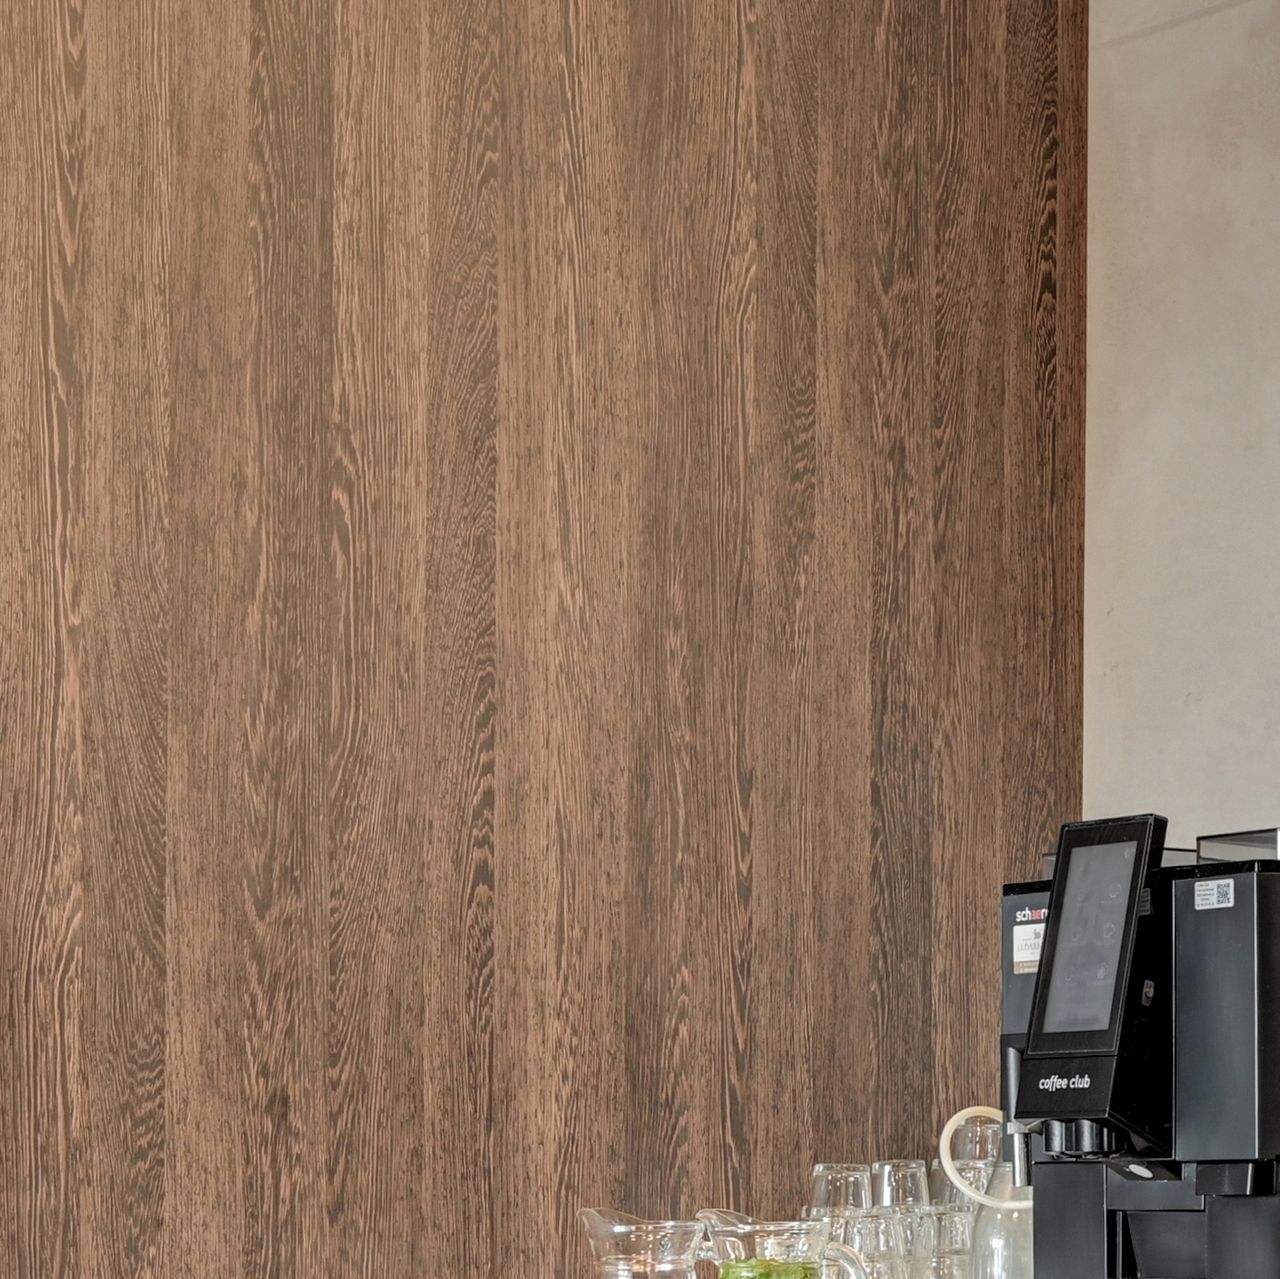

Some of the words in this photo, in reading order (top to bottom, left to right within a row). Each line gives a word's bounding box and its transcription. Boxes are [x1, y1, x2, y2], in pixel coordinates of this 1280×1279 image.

[1016, 907, 1048, 922] schaer
[1039, 1074, 1068, 1092] coffee
[1069, 1074, 1090, 1088] club
